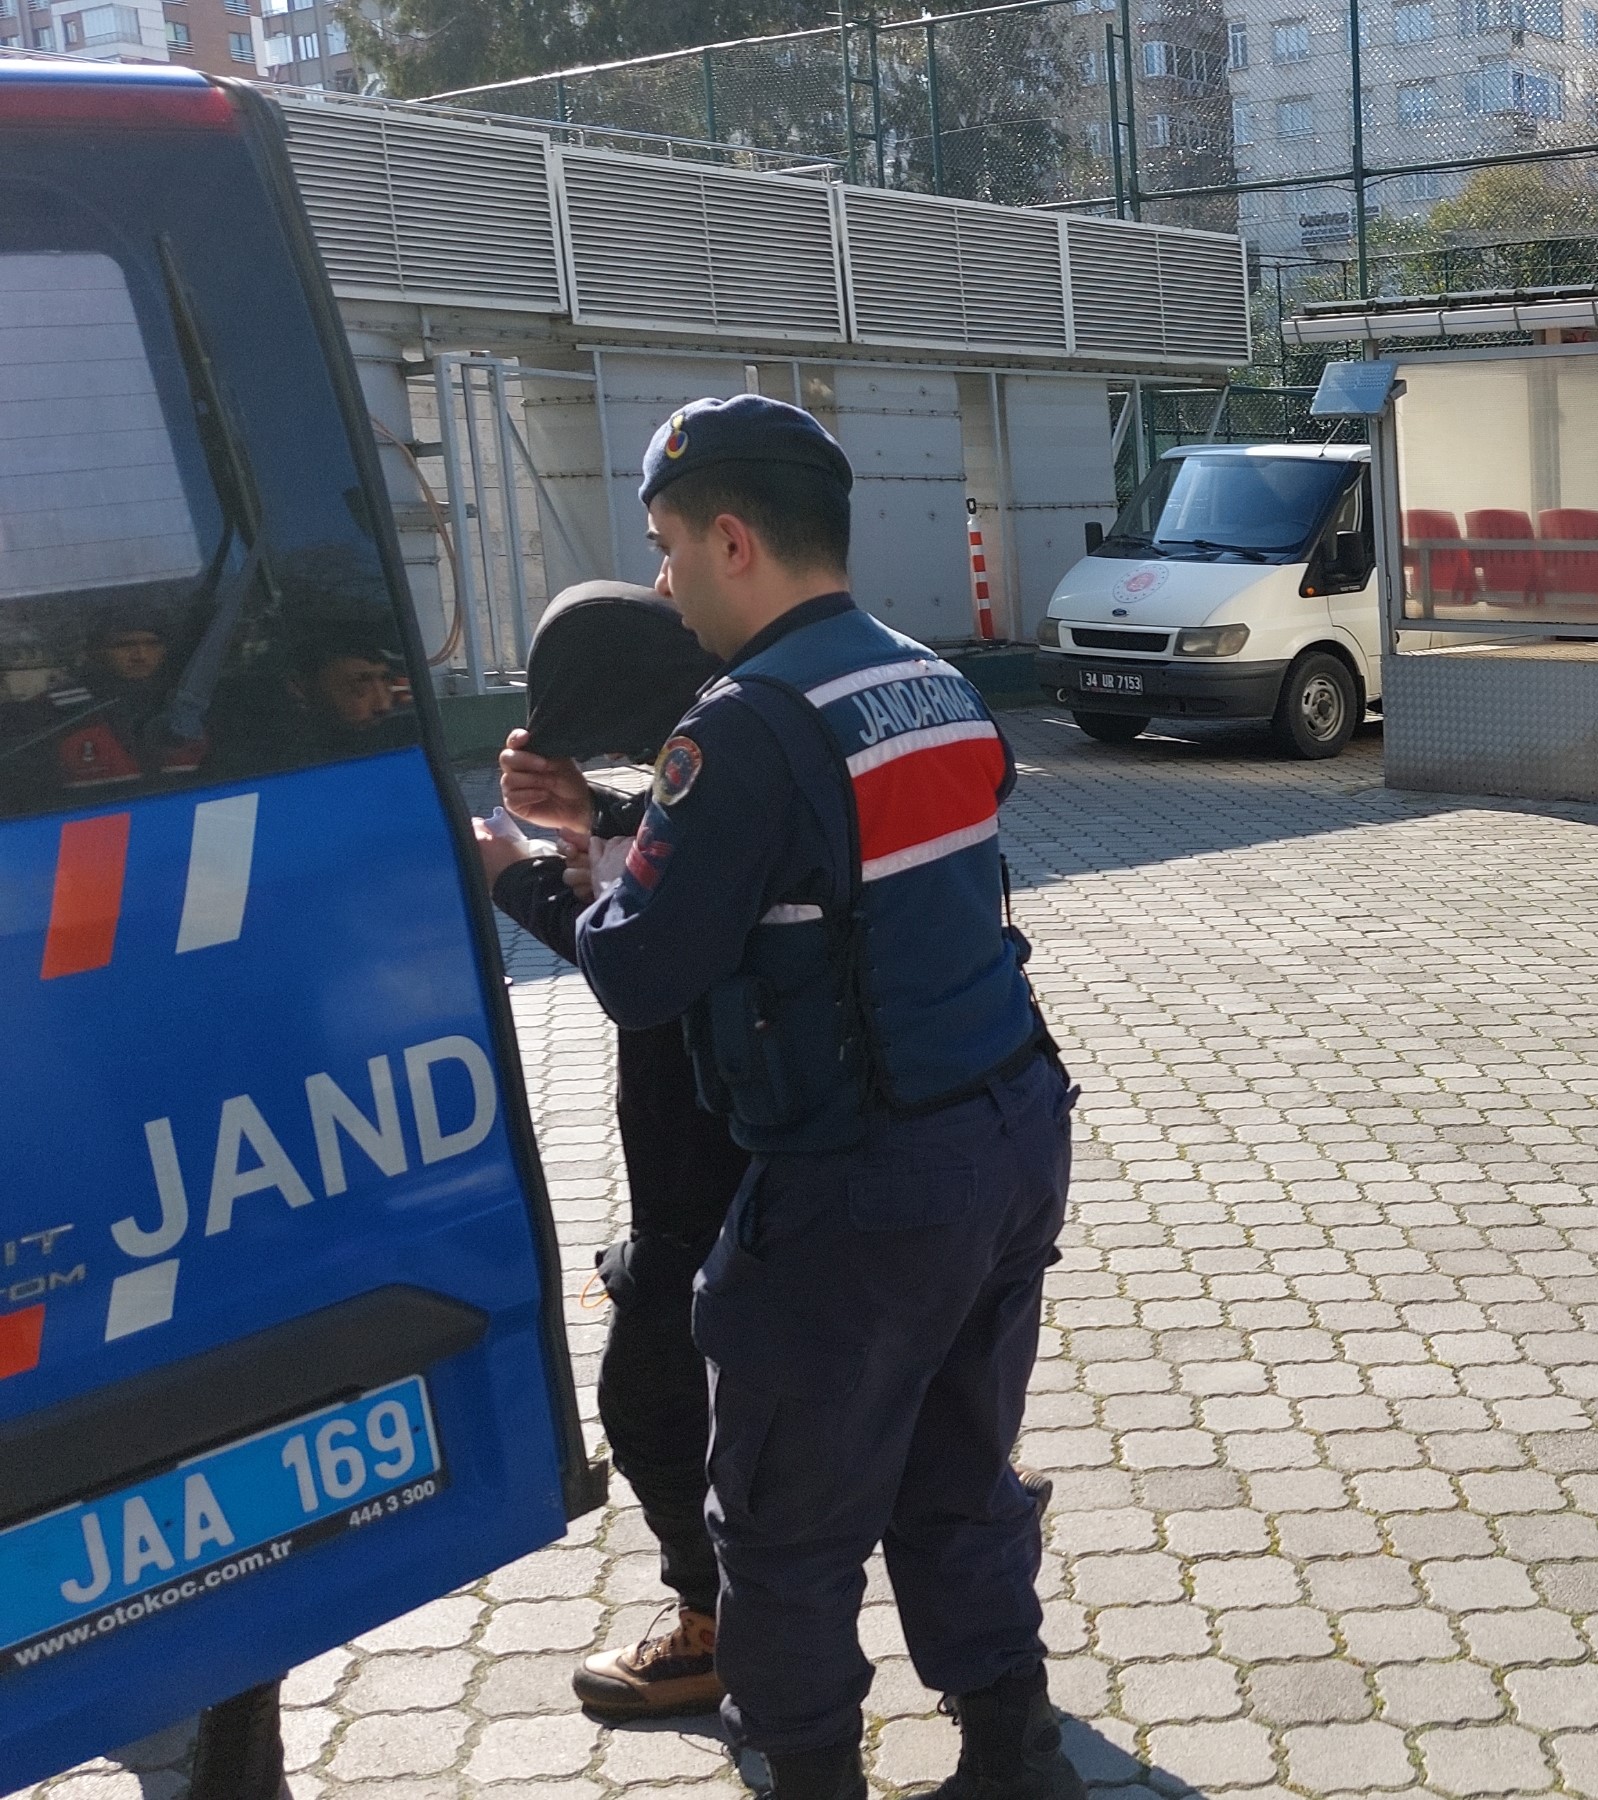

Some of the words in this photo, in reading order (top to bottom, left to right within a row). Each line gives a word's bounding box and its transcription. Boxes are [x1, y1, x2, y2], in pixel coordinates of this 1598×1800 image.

[851, 677, 981, 745] JANDARMA
[1085, 672, 1098, 686] 34
[1116, 675, 1141, 690] 7153
[111, 1035, 497, 1258] JAND
[0, 1263, 87, 1302] OM
[60, 1472, 235, 1604] JAA
[281, 1400, 415, 1513] 169
[349, 1501, 383, 1527] 444
[386, 1495, 399, 1512] 3
[402, 1479, 435, 1506] 300
[14, 1537, 294, 1668] www.otokoc.com.tr
